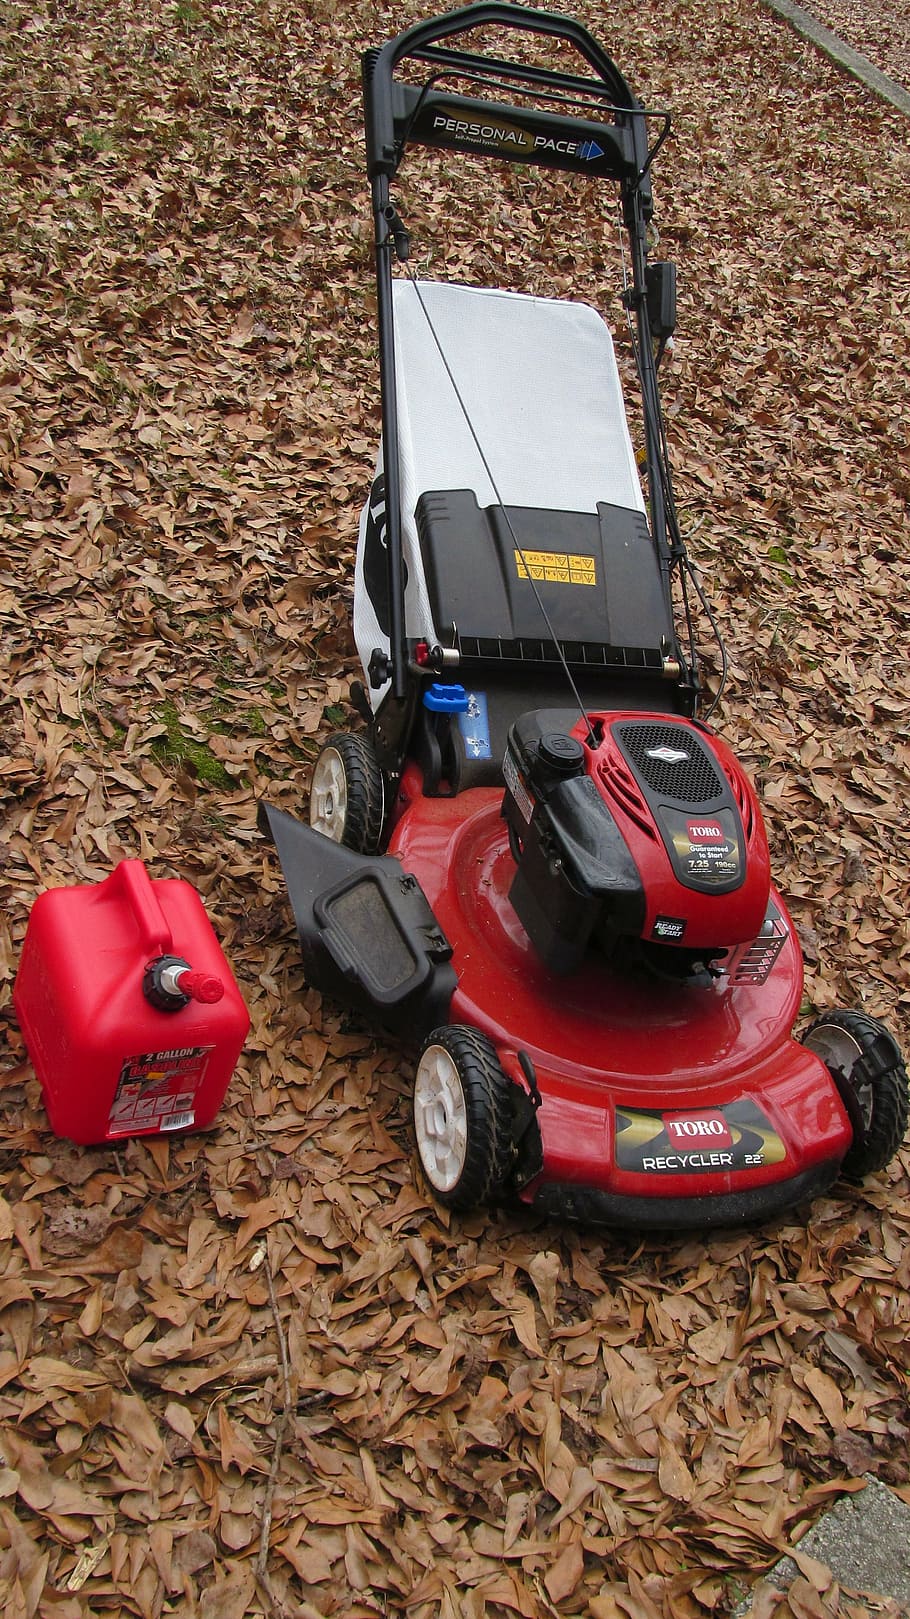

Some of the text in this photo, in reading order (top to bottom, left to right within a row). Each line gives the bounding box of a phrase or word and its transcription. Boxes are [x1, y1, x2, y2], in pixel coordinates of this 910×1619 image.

[433, 116, 577, 154] PERSONAL PACE
[690, 826, 721, 837] TORO
[688, 860, 737, 869] 7.25 190cc
[654, 922, 683, 931] READY
[145, 1053, 154, 1062] 2
[156, 1047, 194, 1061] GALLON
[670, 1119, 724, 1137] TORO
[642, 1153, 733, 1171] RECYCLER
